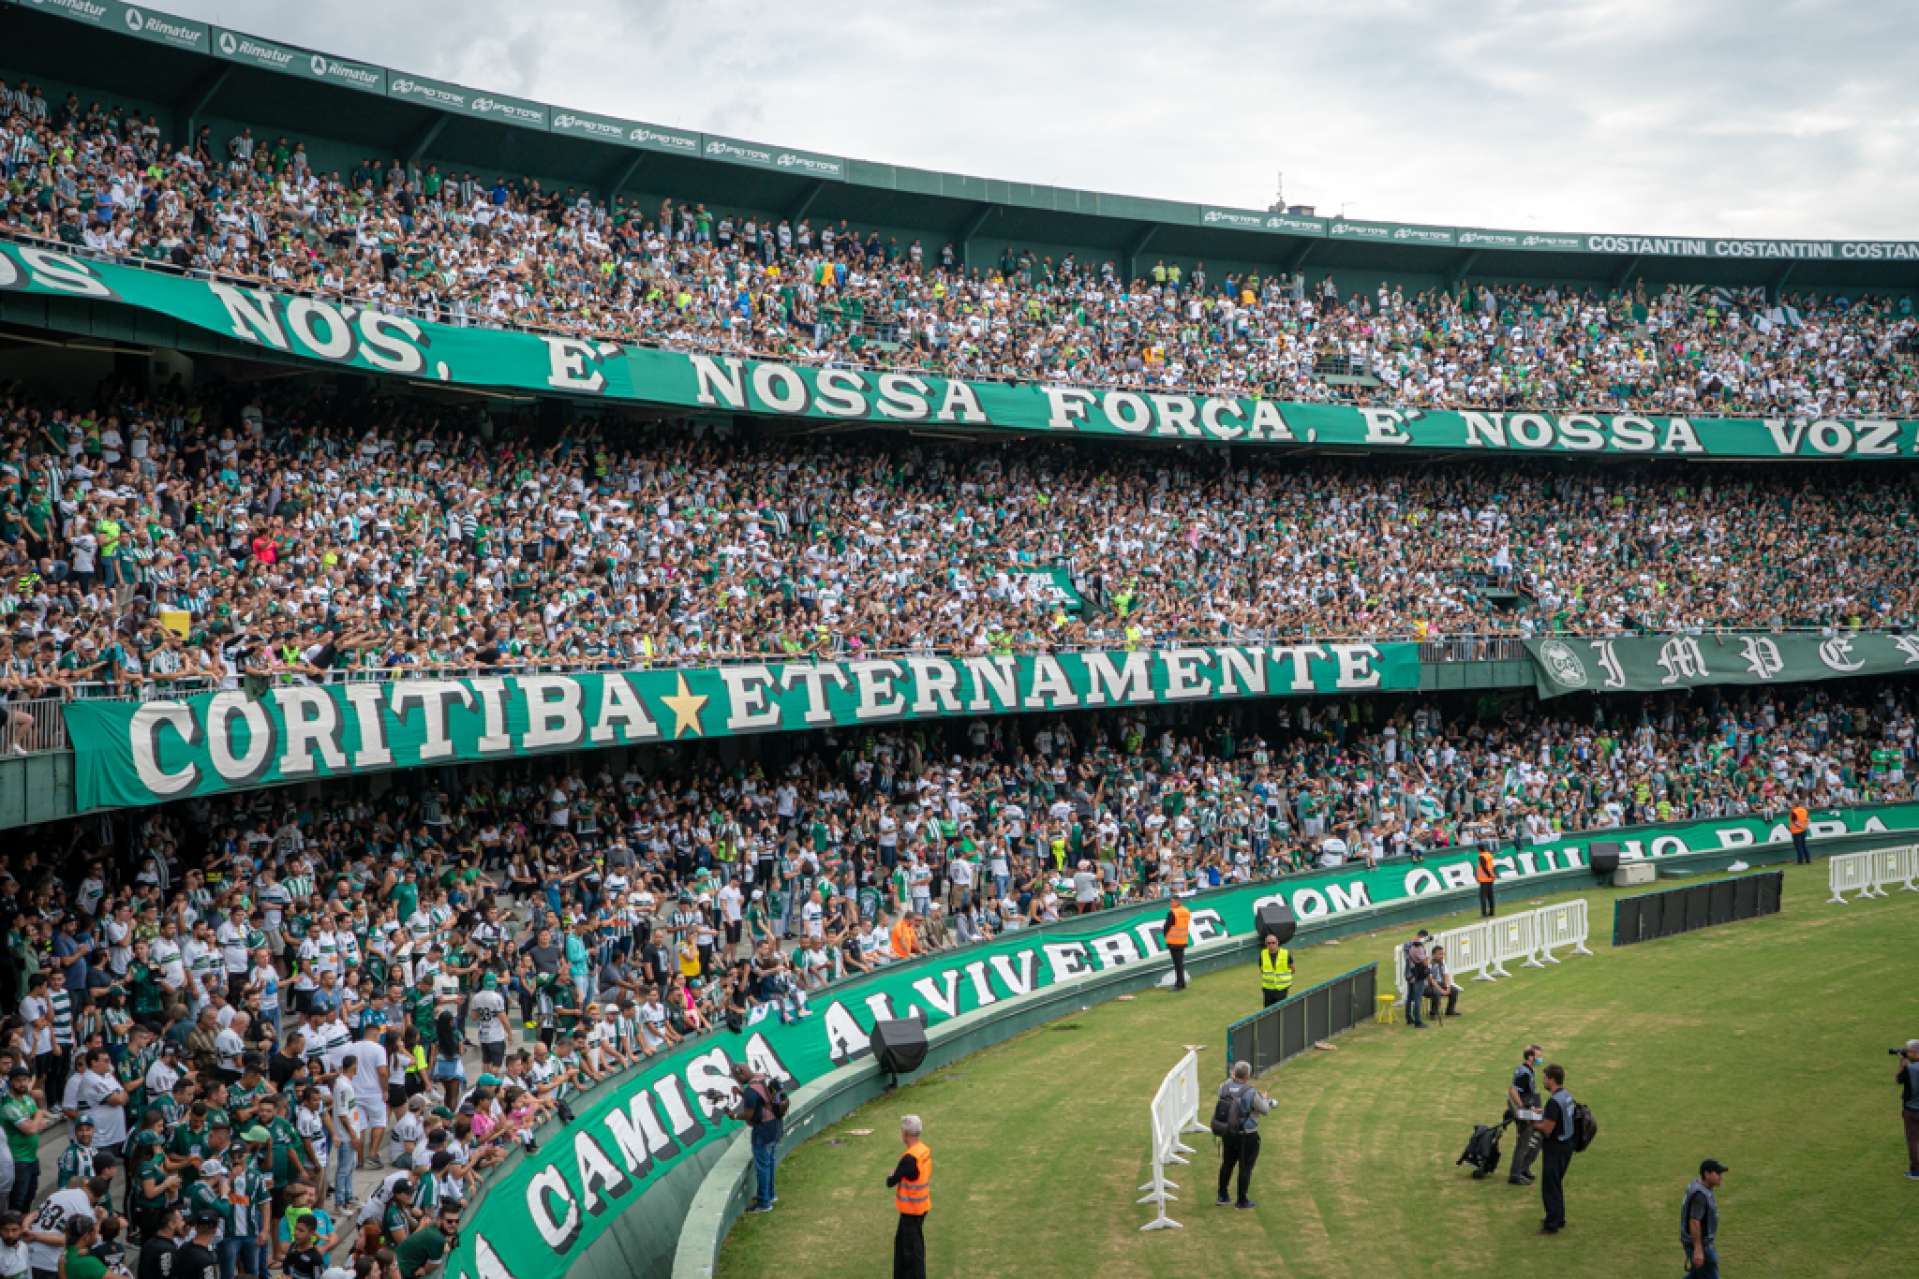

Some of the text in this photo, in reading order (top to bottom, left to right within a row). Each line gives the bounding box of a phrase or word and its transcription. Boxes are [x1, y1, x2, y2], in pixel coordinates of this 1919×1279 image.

[146, 17, 201, 41] Rimatur
[239, 40, 294, 63] Rimatur
[327, 62, 379, 83] Rimatur
[1588, 236, 1706, 256] COSTANTINI
[1715, 241, 1832, 257] COSTANTINI
[690, 353, 986, 422] NOSSA
[1458, 411, 1702, 451] NOSSA
[1763, 419, 1919, 453] VOZ
[129, 643, 1381, 794] CORITIBA ETERNAMENTE
[526, 1031, 792, 1248] CAMISA
